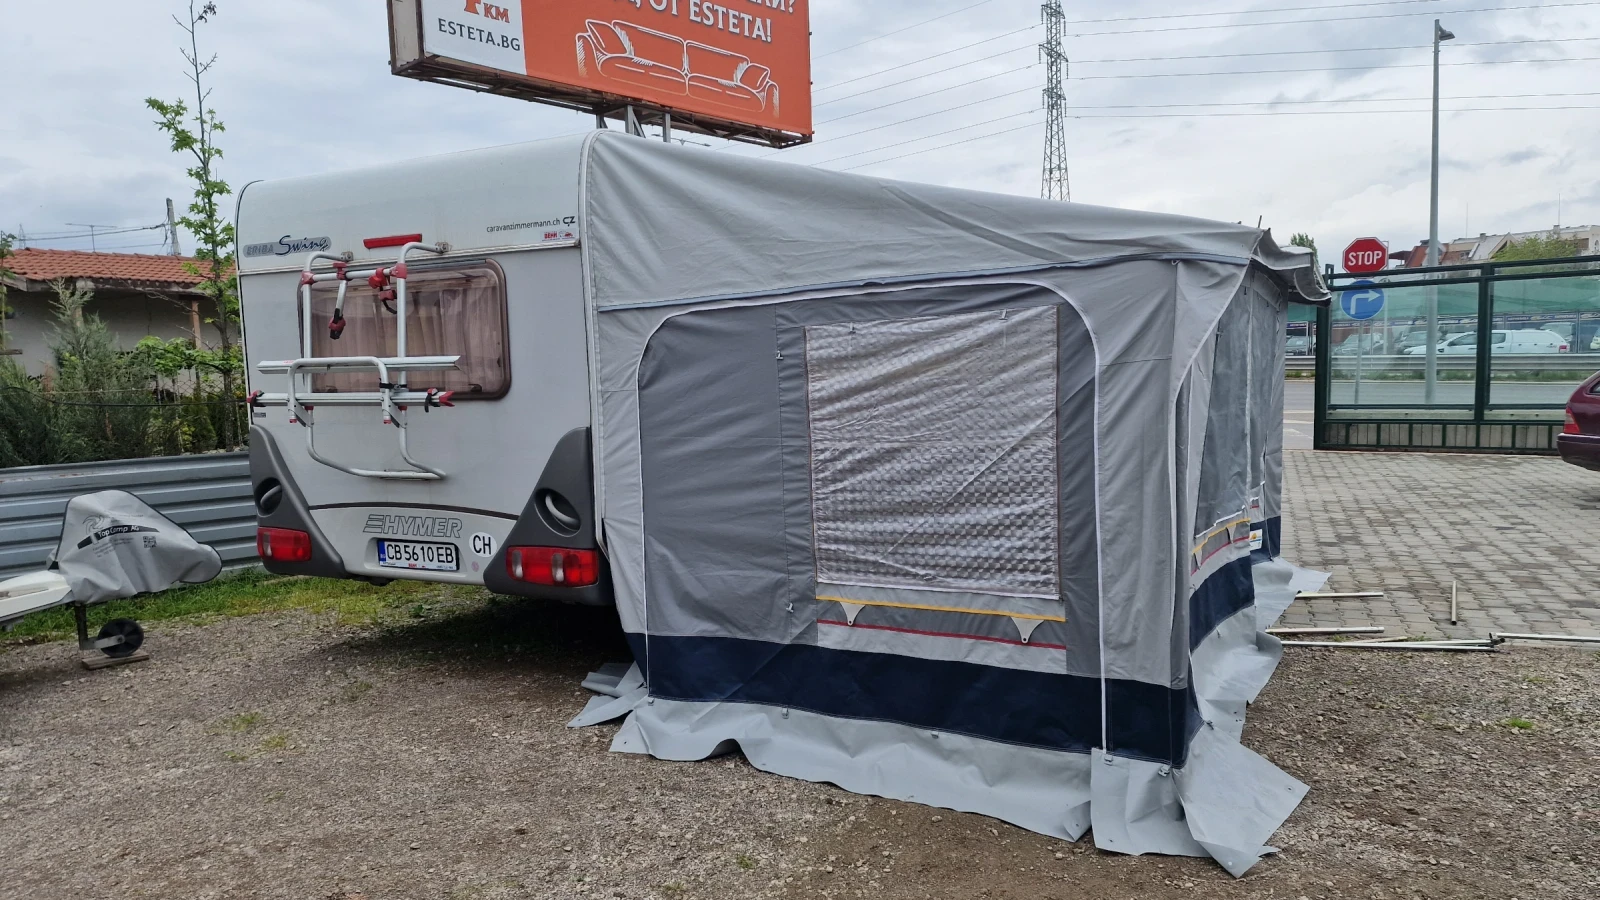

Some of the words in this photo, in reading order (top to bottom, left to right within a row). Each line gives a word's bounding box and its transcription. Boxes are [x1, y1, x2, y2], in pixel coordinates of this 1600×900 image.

[689, 0, 772, 43] ESTETA!
[438, 18, 520, 51] ESTETA.BG
[486, 218, 560, 233] caravanzimmermann.ch
[246, 244, 274, 256] ERIBA
[275, 235, 328, 256] Swing
[1348, 250, 1383, 266] STOP
[383, 514, 463, 538] HYMER
[472, 534, 491, 555] CH
